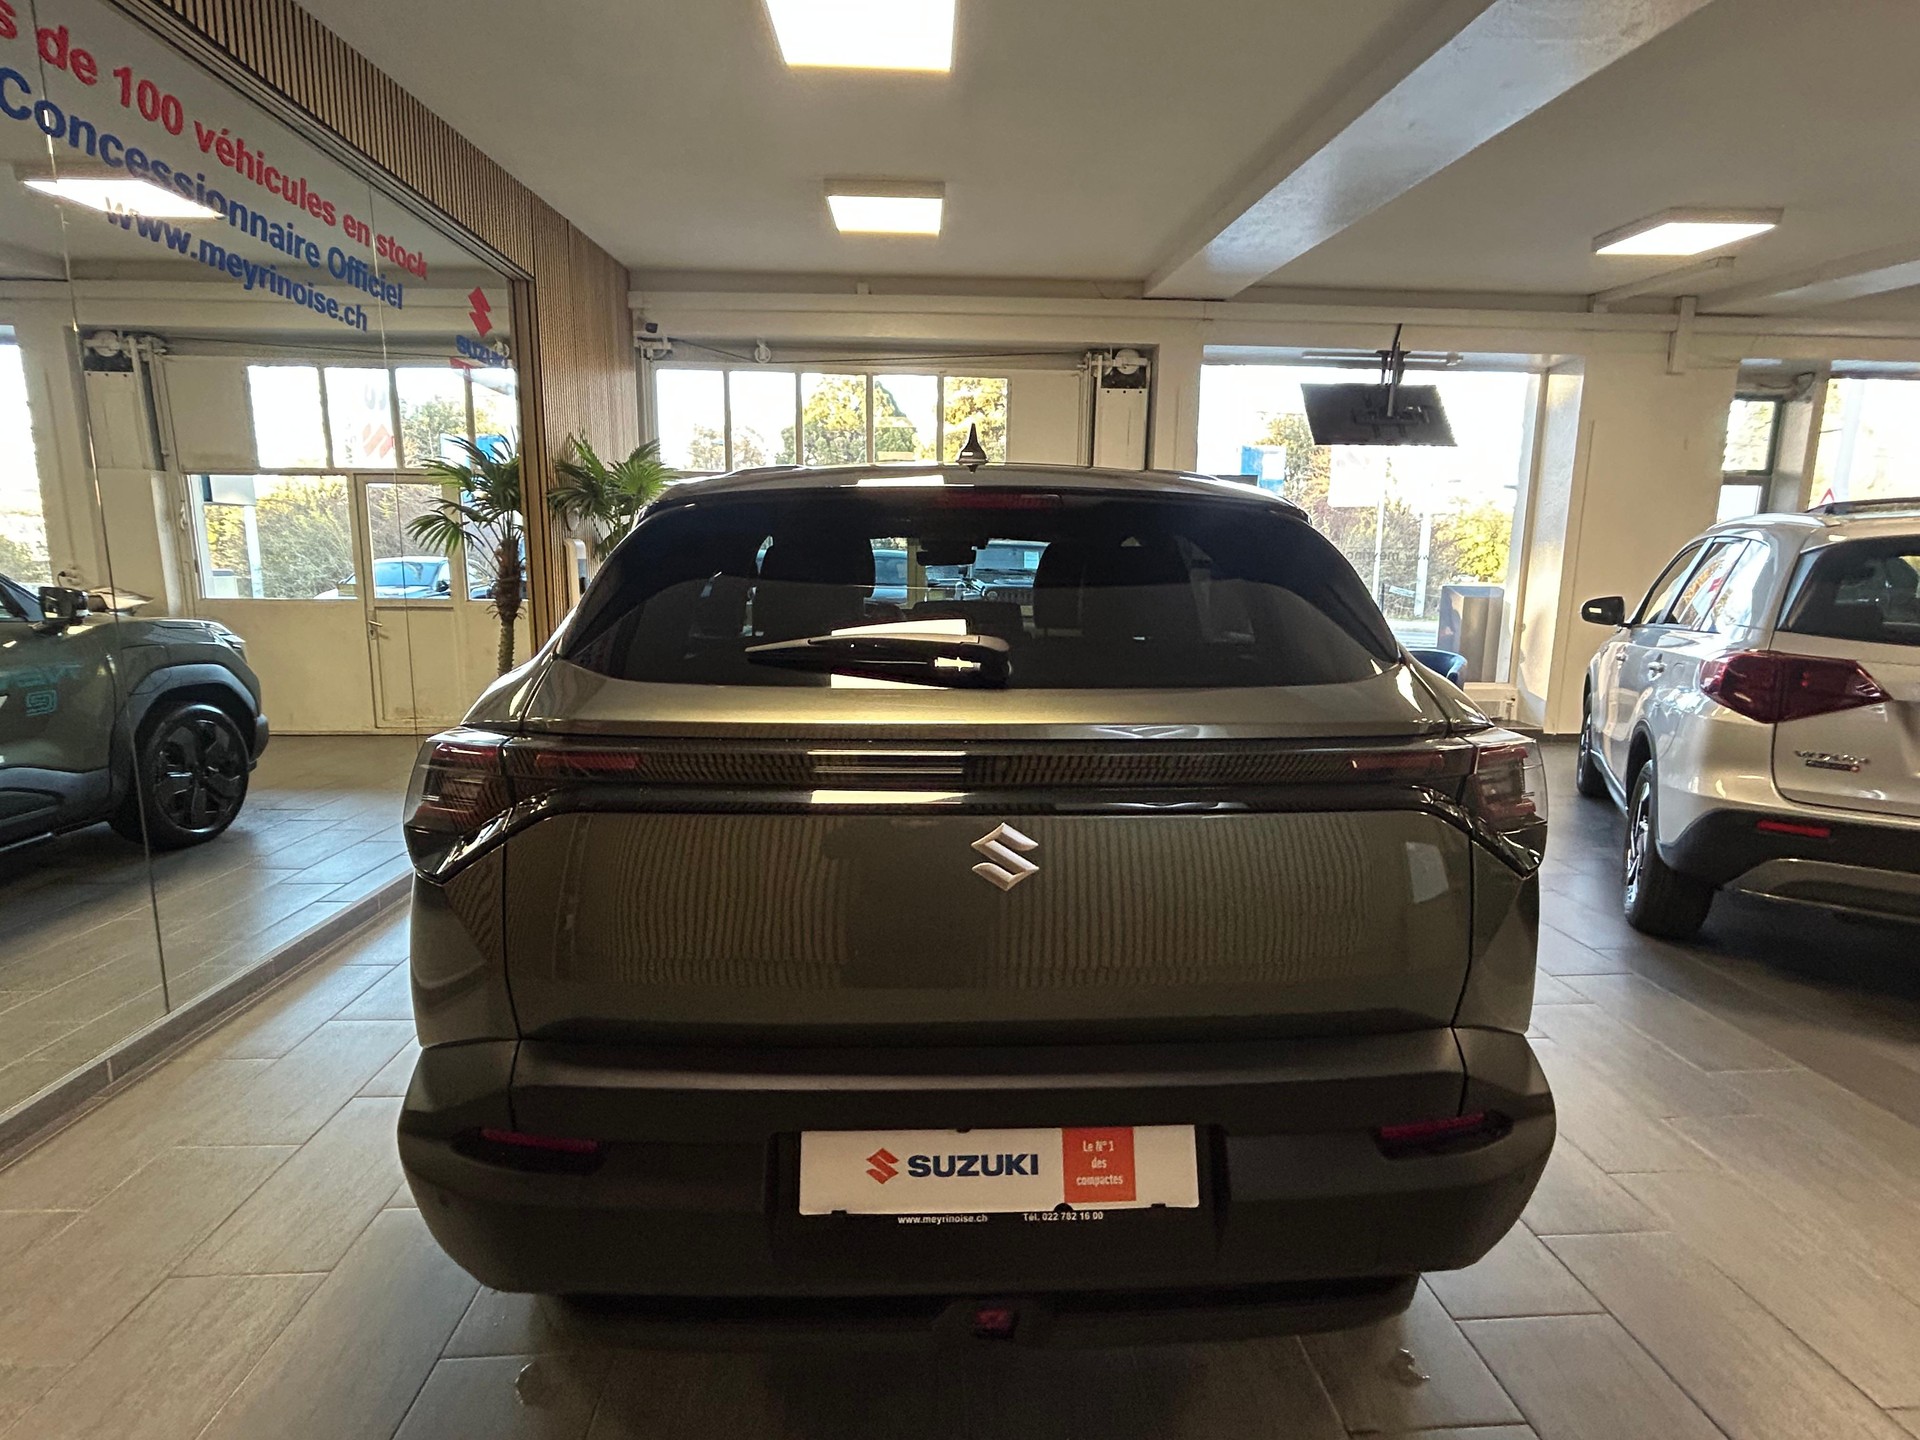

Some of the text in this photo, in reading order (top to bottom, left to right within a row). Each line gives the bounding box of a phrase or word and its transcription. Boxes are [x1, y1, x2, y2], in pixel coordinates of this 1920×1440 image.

[37, 25, 98, 86] de
[113, 67, 183, 136] 100
[194, 120, 337, 227] véhicules
[343, 213, 370, 247] en
[376, 232, 428, 281] stock
[0, 67, 403, 310] Concessionnaire Officiel
[1083, 1140, 1094, 1152] Le
[907, 1153, 1039, 1178] SUZUKI
[1091, 1157, 1107, 1169] des
[1076, 1174, 1124, 1187] compactes
[897, 1214, 988, 1225] www.meyrinoise.ch
[1042, 1212, 1059, 1221] 022
[1080, 1211, 1091, 1220] 16
[1092, 1211, 1104, 1220] 00
